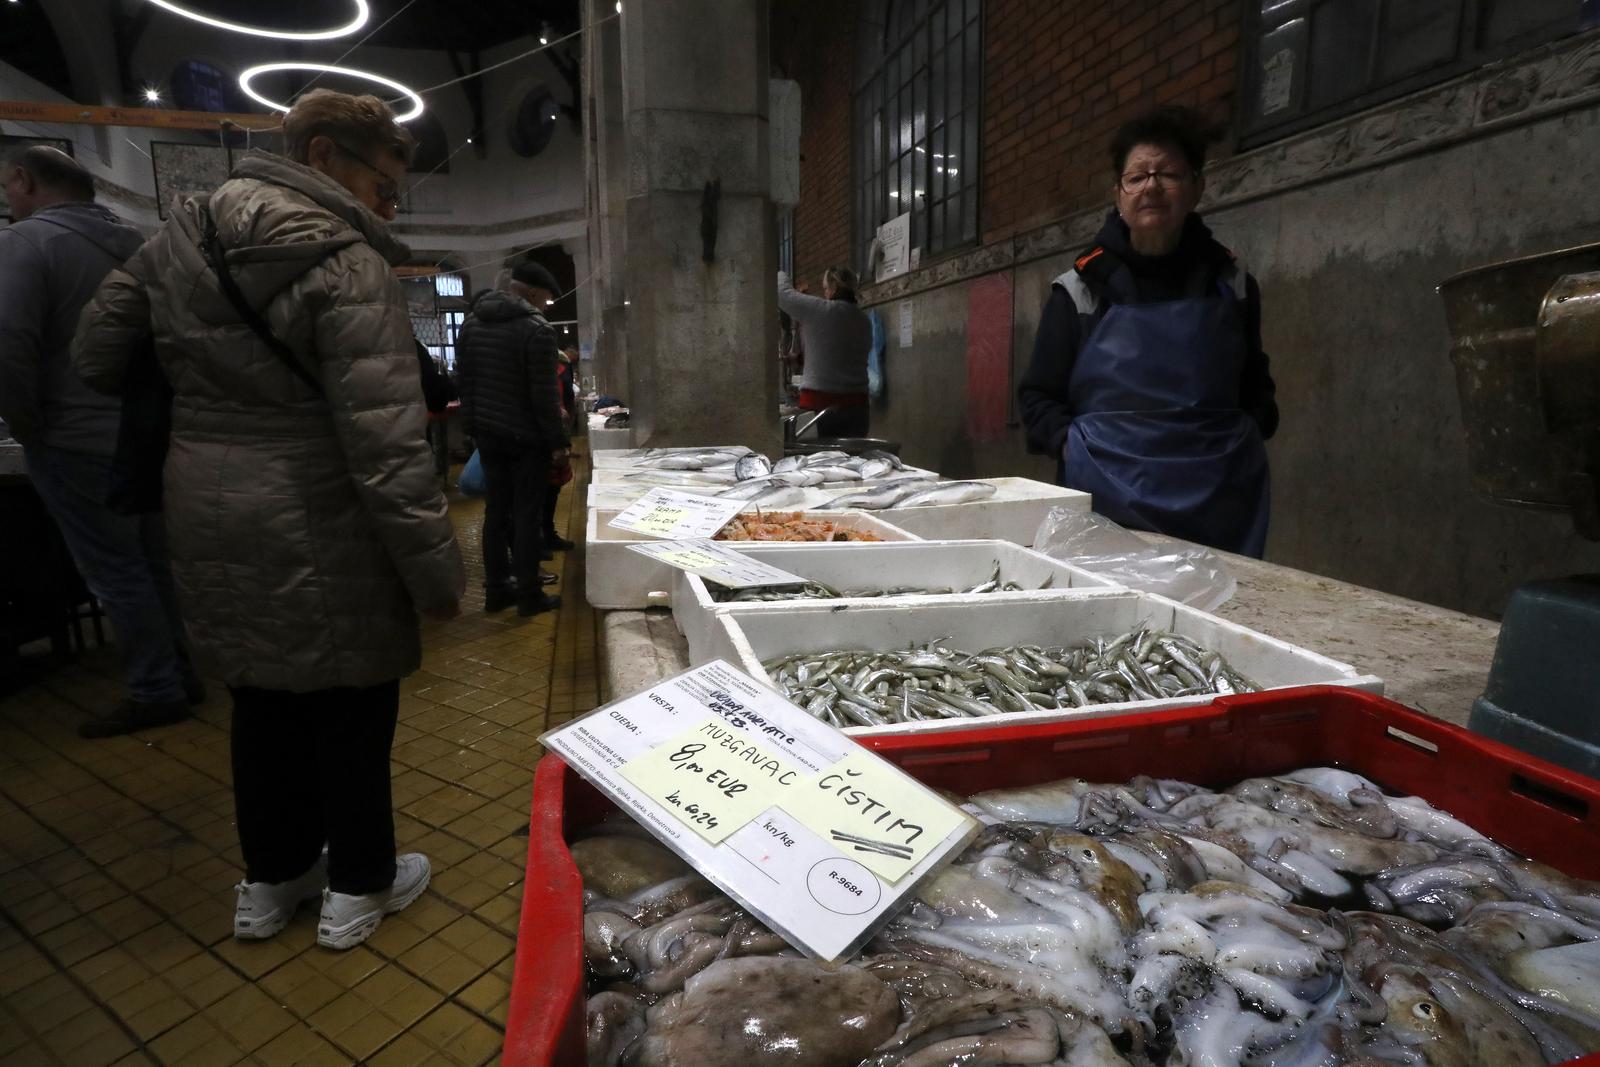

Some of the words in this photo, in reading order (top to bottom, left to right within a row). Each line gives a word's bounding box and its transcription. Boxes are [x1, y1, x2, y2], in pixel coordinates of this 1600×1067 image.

[740, 711, 795, 744] ADRIATIC
[700, 722, 797, 785] MUZGAVAC
[706, 769, 747, 798] EUR
[819, 769, 923, 844] ČISTIM
[763, 821, 796, 848] kn/kg
[829, 870, 863, 897] R-9684
